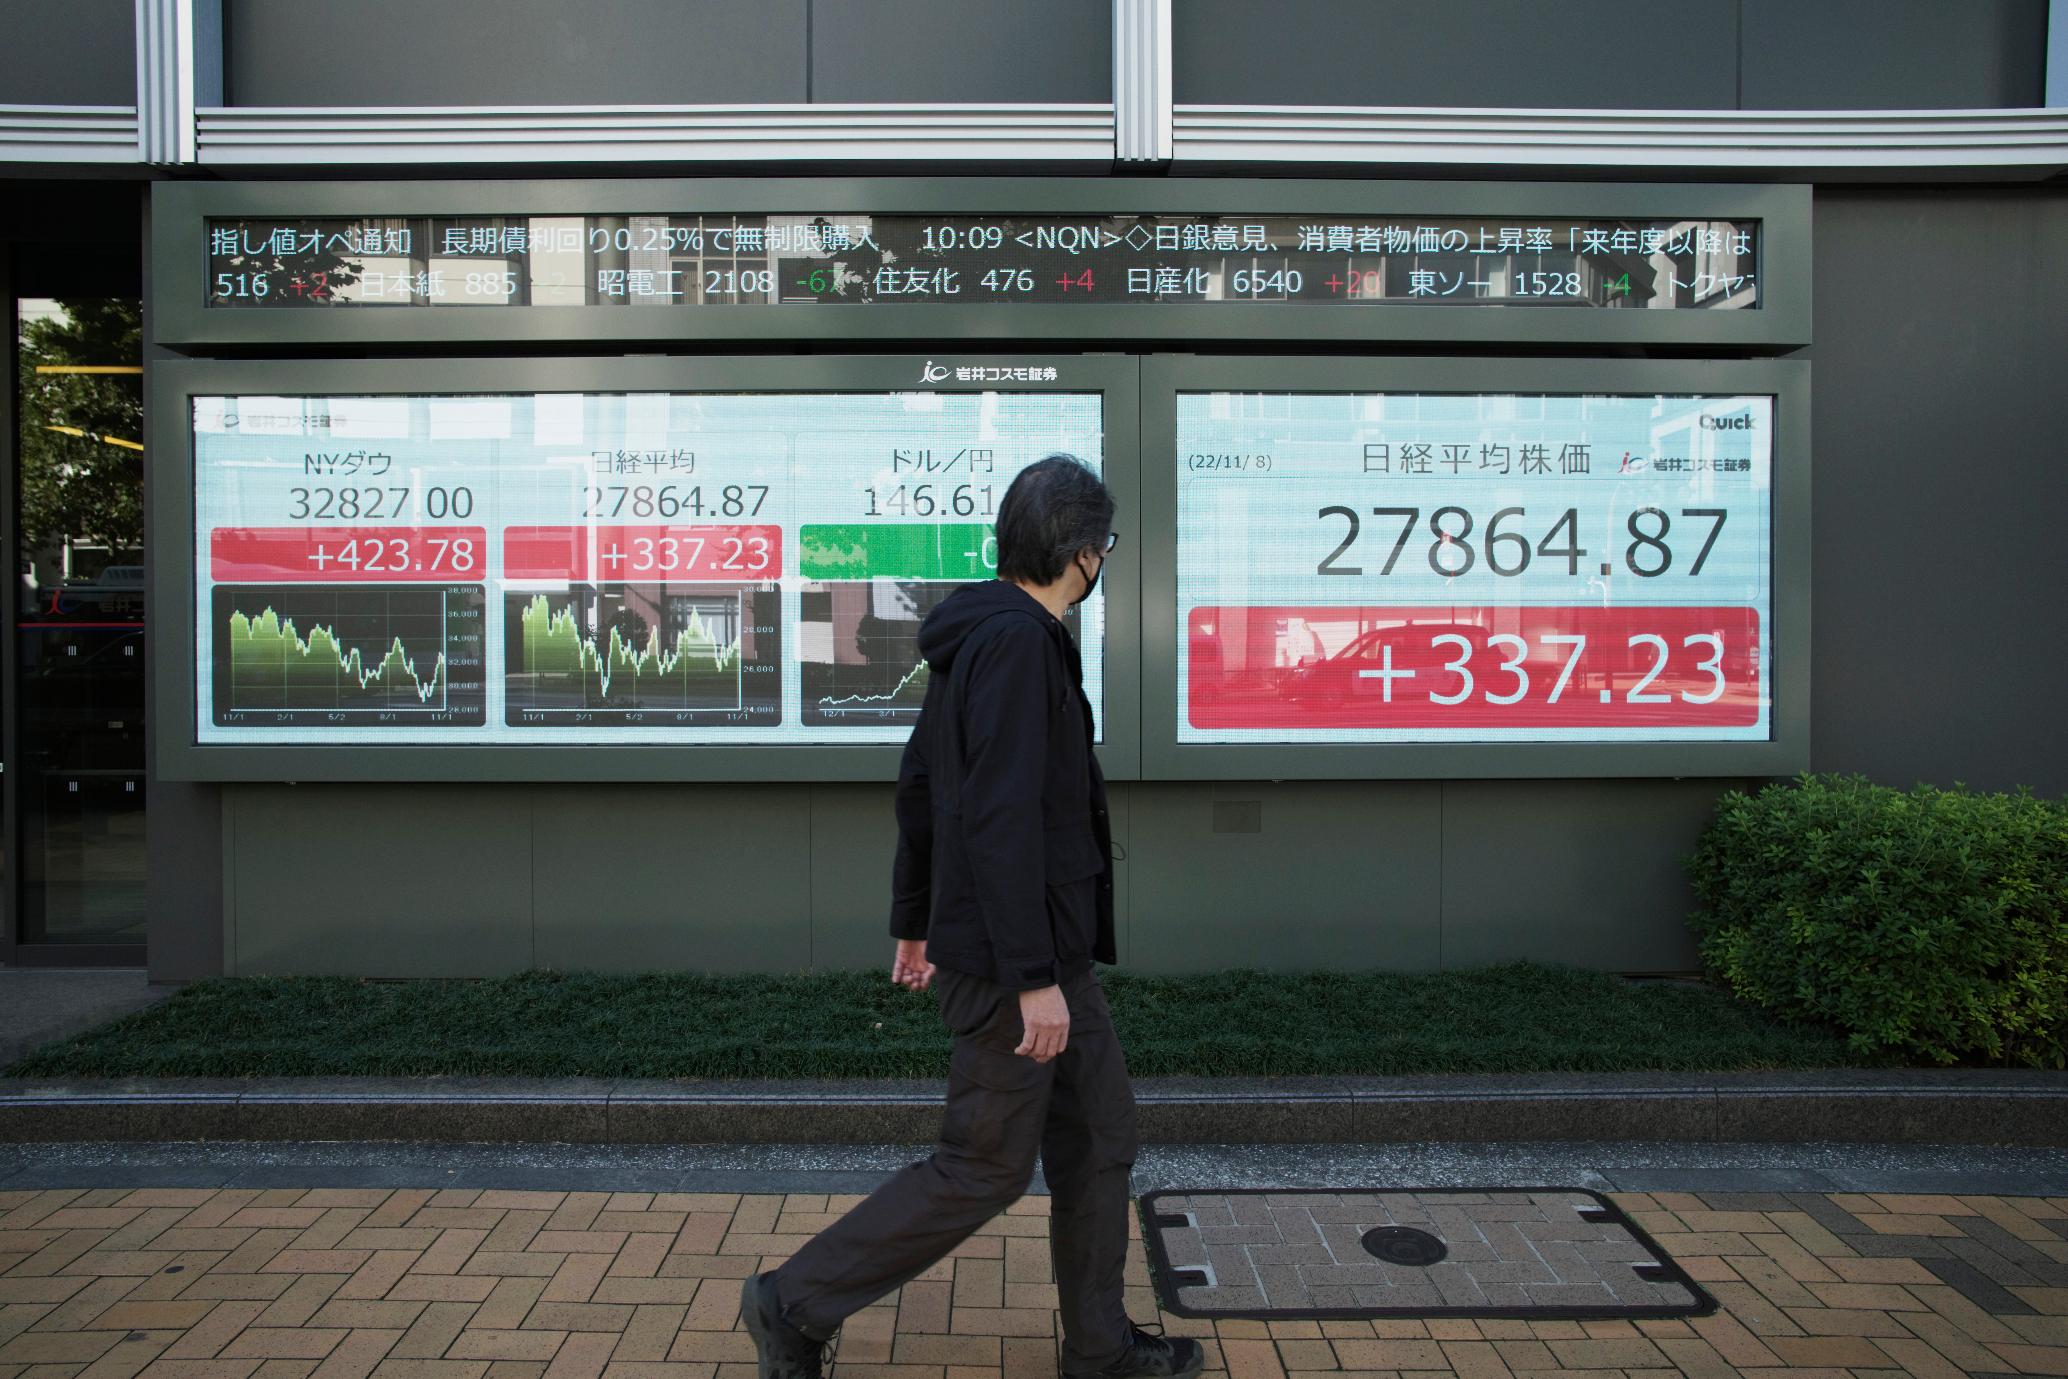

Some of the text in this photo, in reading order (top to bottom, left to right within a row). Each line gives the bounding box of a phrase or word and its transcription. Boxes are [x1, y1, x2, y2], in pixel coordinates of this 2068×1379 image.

[211, 227, 412, 256] 指し値オペ通知
[922, 226, 1003, 250] 10:09
[217, 273, 268, 297] 516
[360, 271, 446, 298] 日本紙
[465, 272, 517, 296] 885
[598, 269, 684, 297] 昭電工
[704, 270, 775, 294] 2108
[873, 267, 961, 296] 住友化
[980, 268, 1035, 293] 476
[1055, 268, 1095, 293] +4
[1127, 267, 1211, 295] 日産化
[1233, 269, 1303, 294] 6540
[1408, 268, 1494, 296] 東ソー
[1514, 271, 1582, 296] 1528
[955, 366, 1058, 382] 岩井コスモ証券
[304, 450, 392, 476] NYダウ
[591, 448, 696, 475] 日経平均
[1362, 442, 1592, 476] 日経平均株価
[289, 486, 474, 519] 3282700
[582, 484, 770, 518] 27864.87
[863, 484, 994, 517] 146.61
[307, 538, 474, 572] +423.78
[601, 537, 770, 571] +337.23
[1316, 504, 1728, 578] 27864.87
[1358, 633, 1727, 706] +337.23
